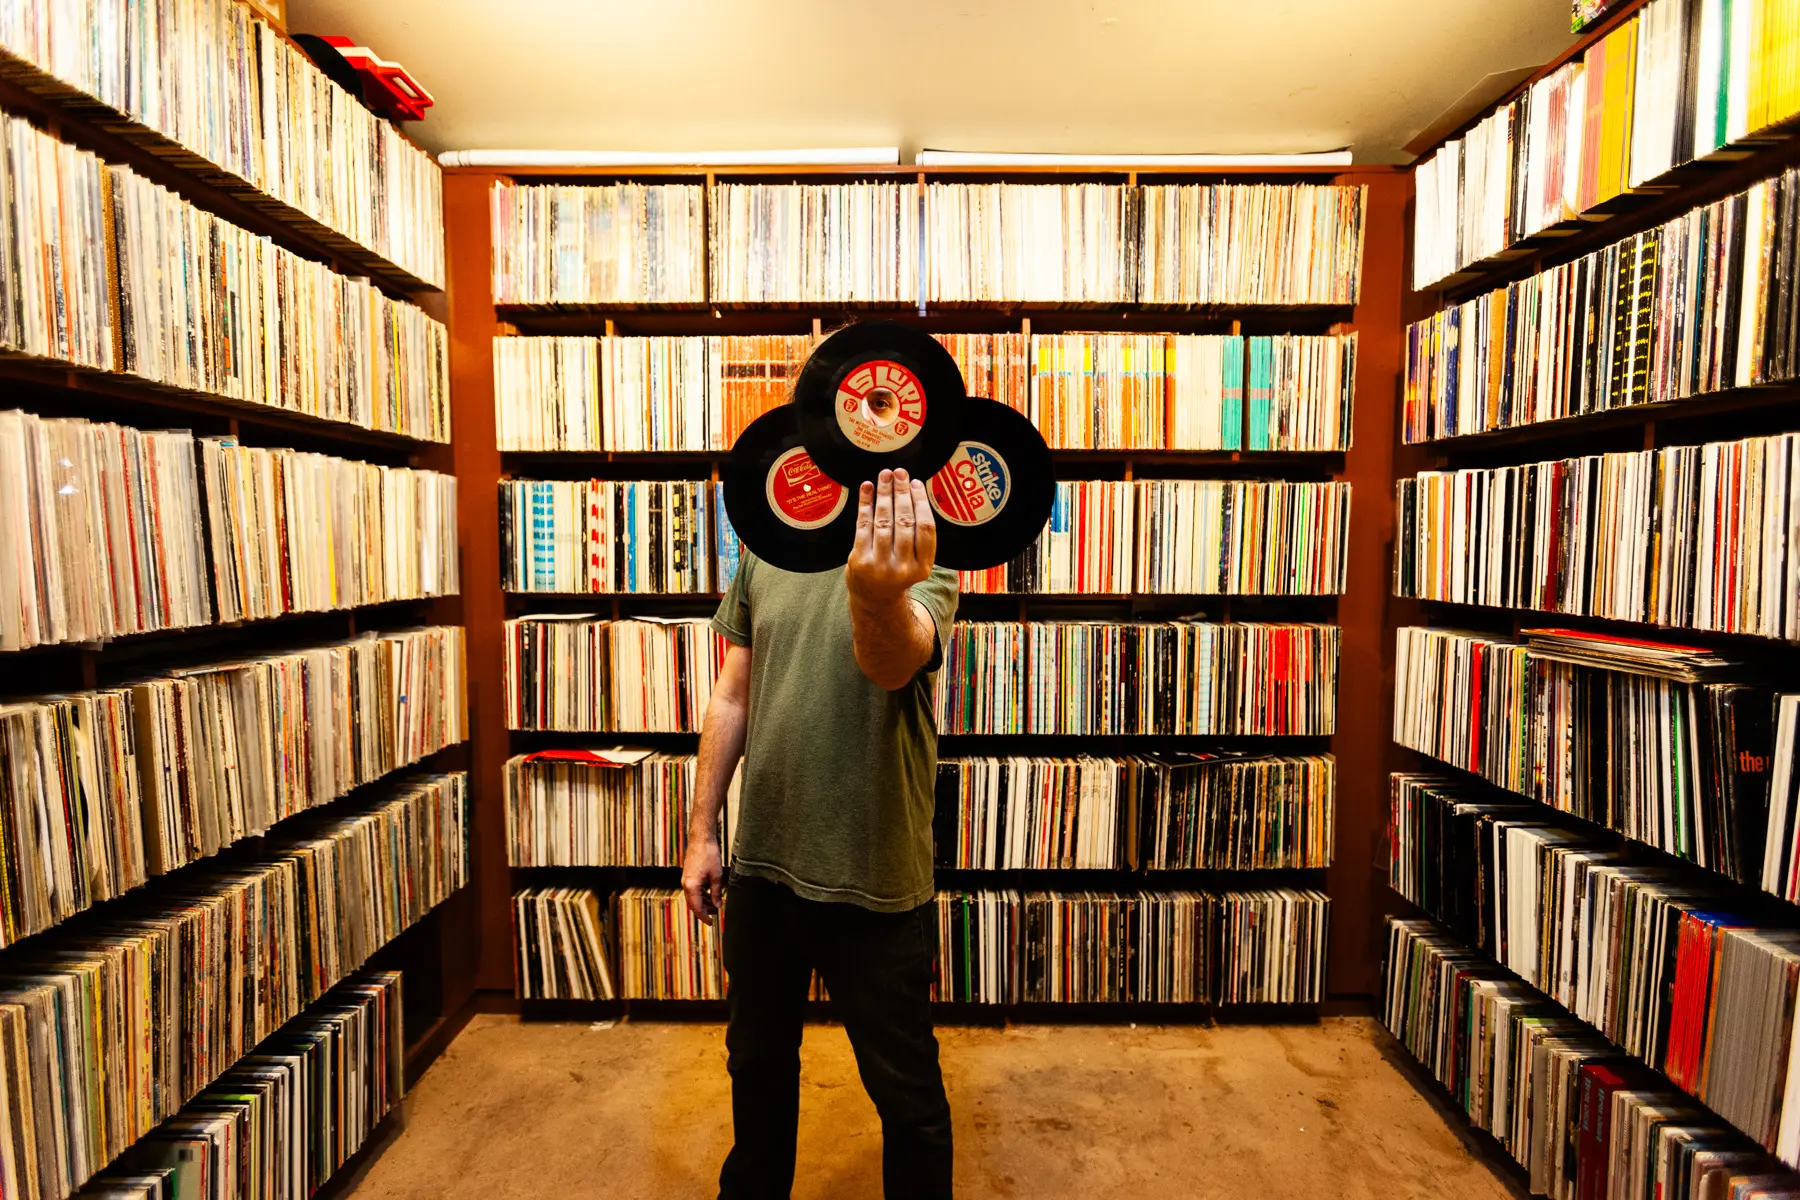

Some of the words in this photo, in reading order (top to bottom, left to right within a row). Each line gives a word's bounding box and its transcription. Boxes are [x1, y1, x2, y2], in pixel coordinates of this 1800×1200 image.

[847, 366, 922, 420] SLURP
[788, 460, 813, 476] Coca-Cola
[955, 460, 985, 510] Cola
[972, 452, 1002, 500] strike
[1740, 750, 1764, 773] the
